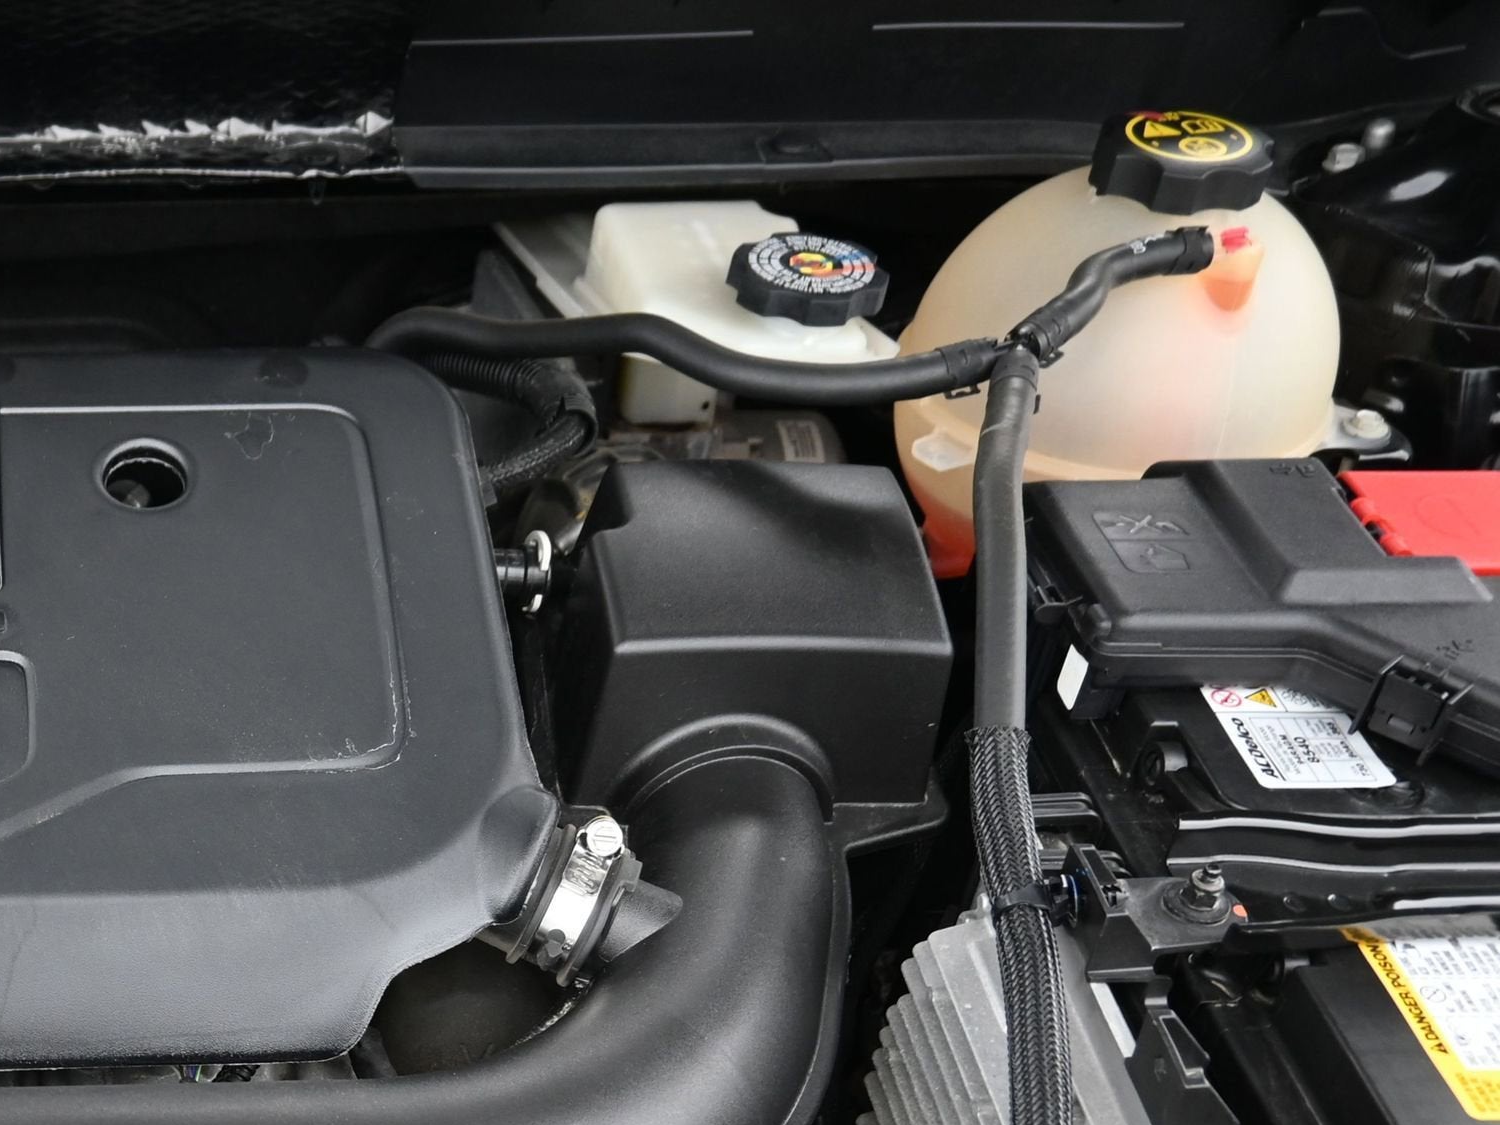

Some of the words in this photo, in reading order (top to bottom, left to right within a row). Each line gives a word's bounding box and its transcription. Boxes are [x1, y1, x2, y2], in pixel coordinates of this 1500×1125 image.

[1231, 717, 1280, 779] ACDelco
[1293, 736, 1321, 763] 8540
[1399, 991, 1440, 1041] DANGER
